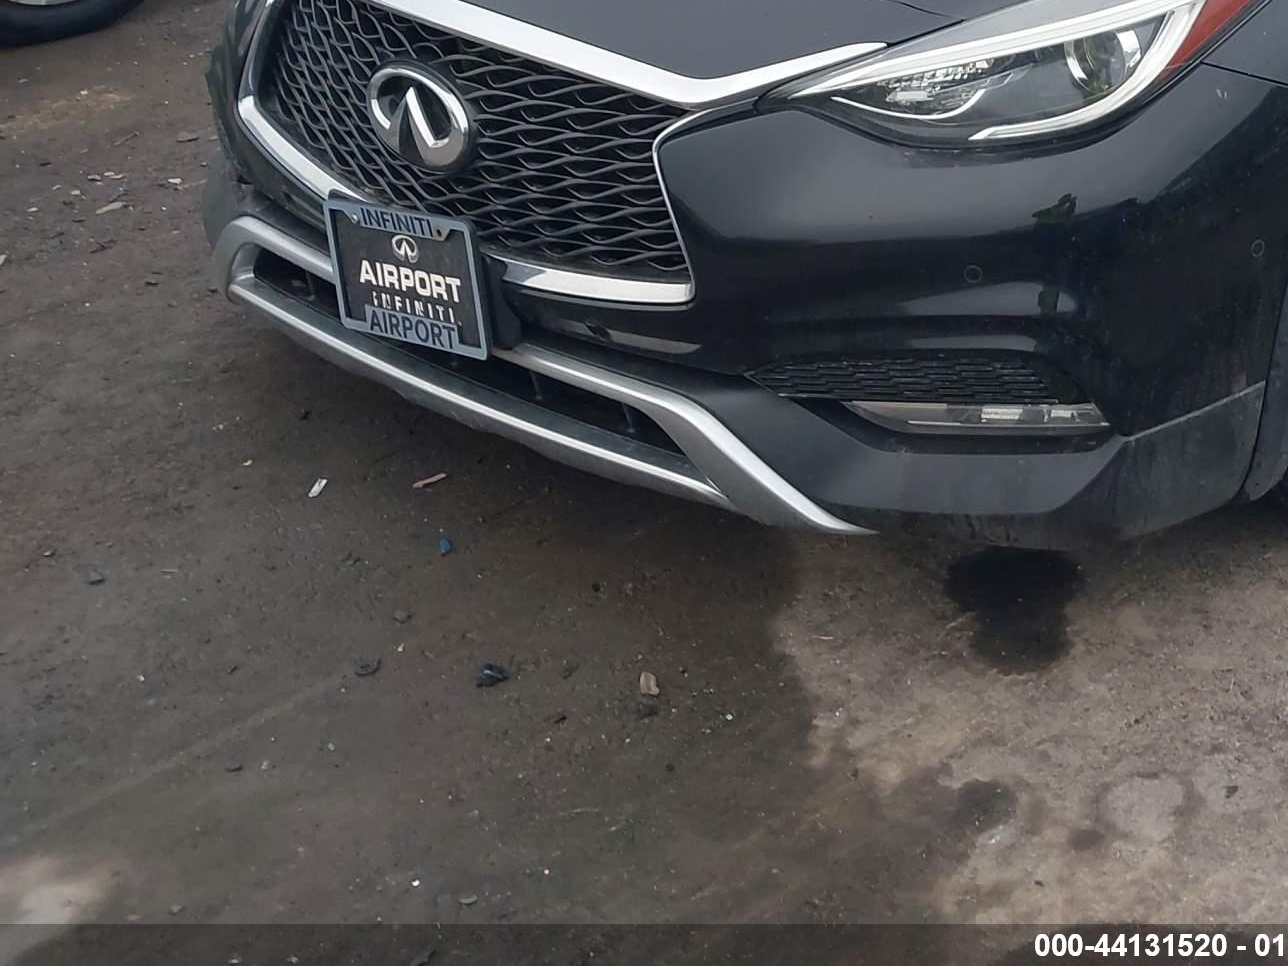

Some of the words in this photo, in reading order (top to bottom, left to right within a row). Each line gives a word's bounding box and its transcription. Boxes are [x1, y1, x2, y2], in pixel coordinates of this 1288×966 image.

[360, 207, 433, 237] INFINITI
[360, 260, 461, 302] AIRPORT
[372, 291, 455, 323] INFINITI
[369, 310, 455, 349] AIRPORT
